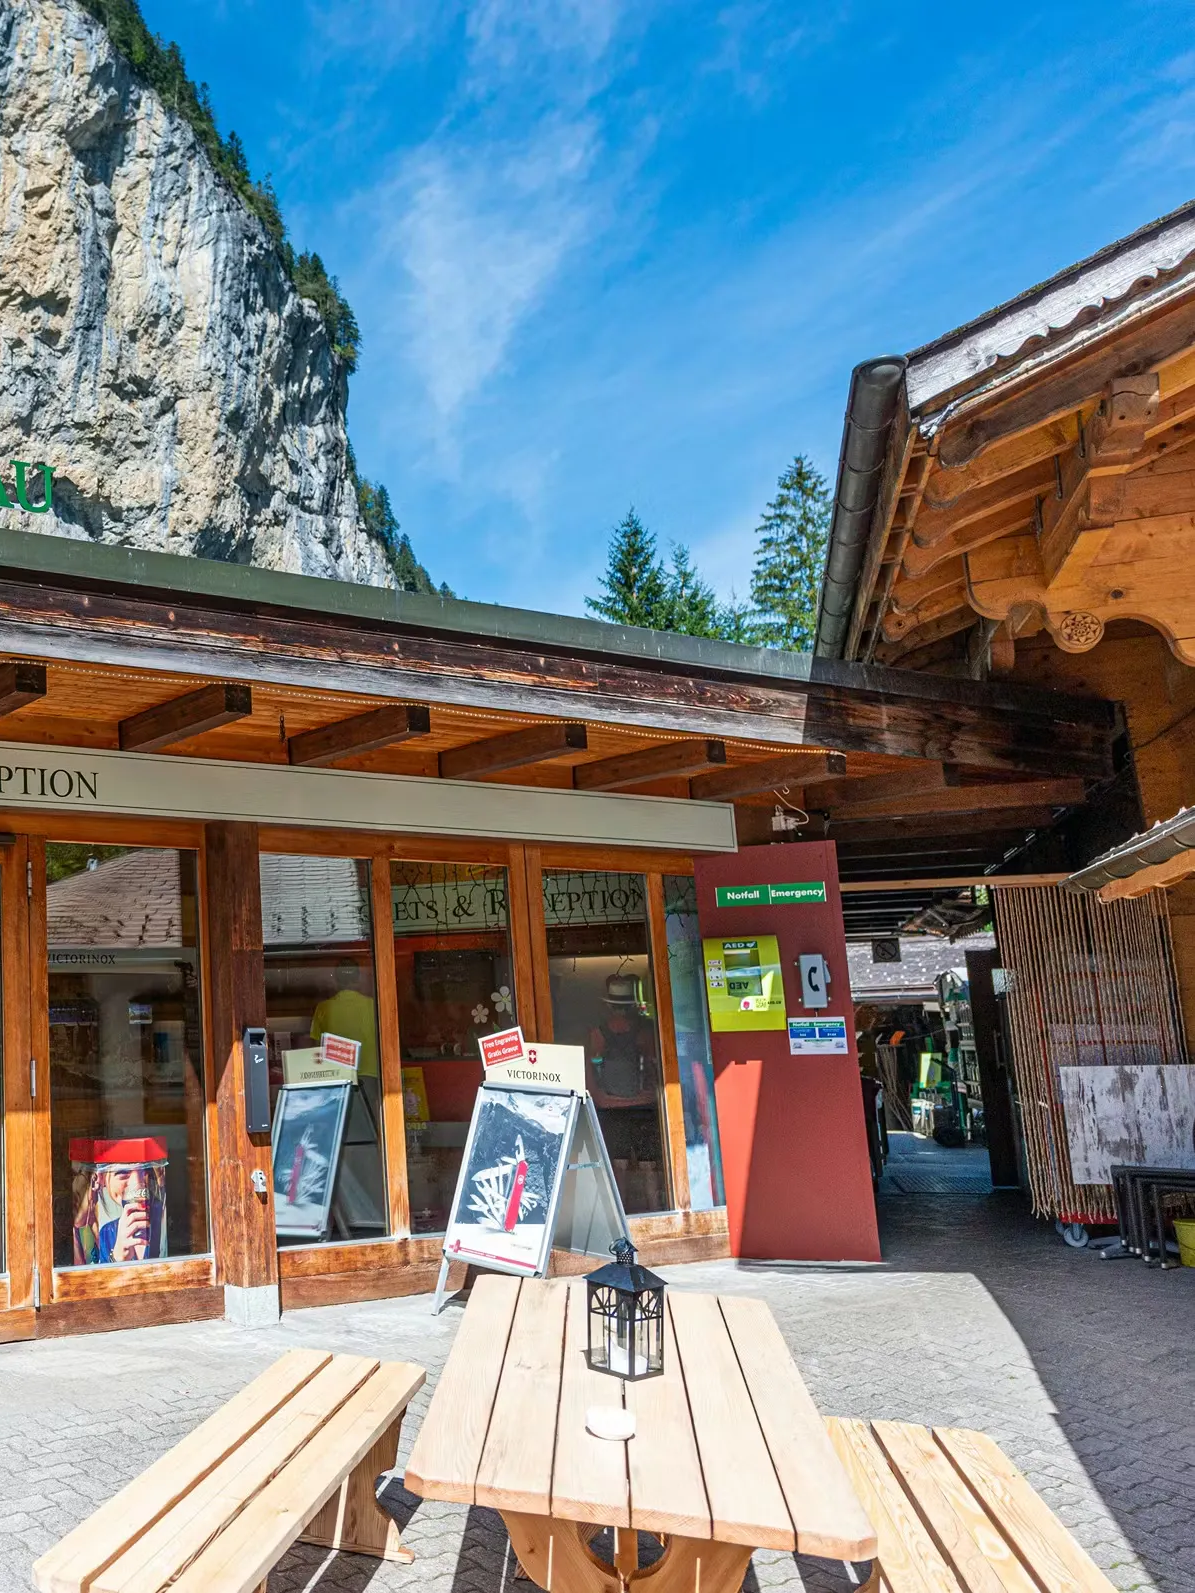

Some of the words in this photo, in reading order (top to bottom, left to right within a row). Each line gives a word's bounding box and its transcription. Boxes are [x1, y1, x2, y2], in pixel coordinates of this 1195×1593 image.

[726, 890, 760, 900] Notfall
[770, 889, 824, 898] Emergency
[452, 894, 476, 918] &
[494, 1034, 519, 1046] Engraving
[487, 1050, 502, 1059] Gratis
[507, 1069, 561, 1083] VICTORINOX
